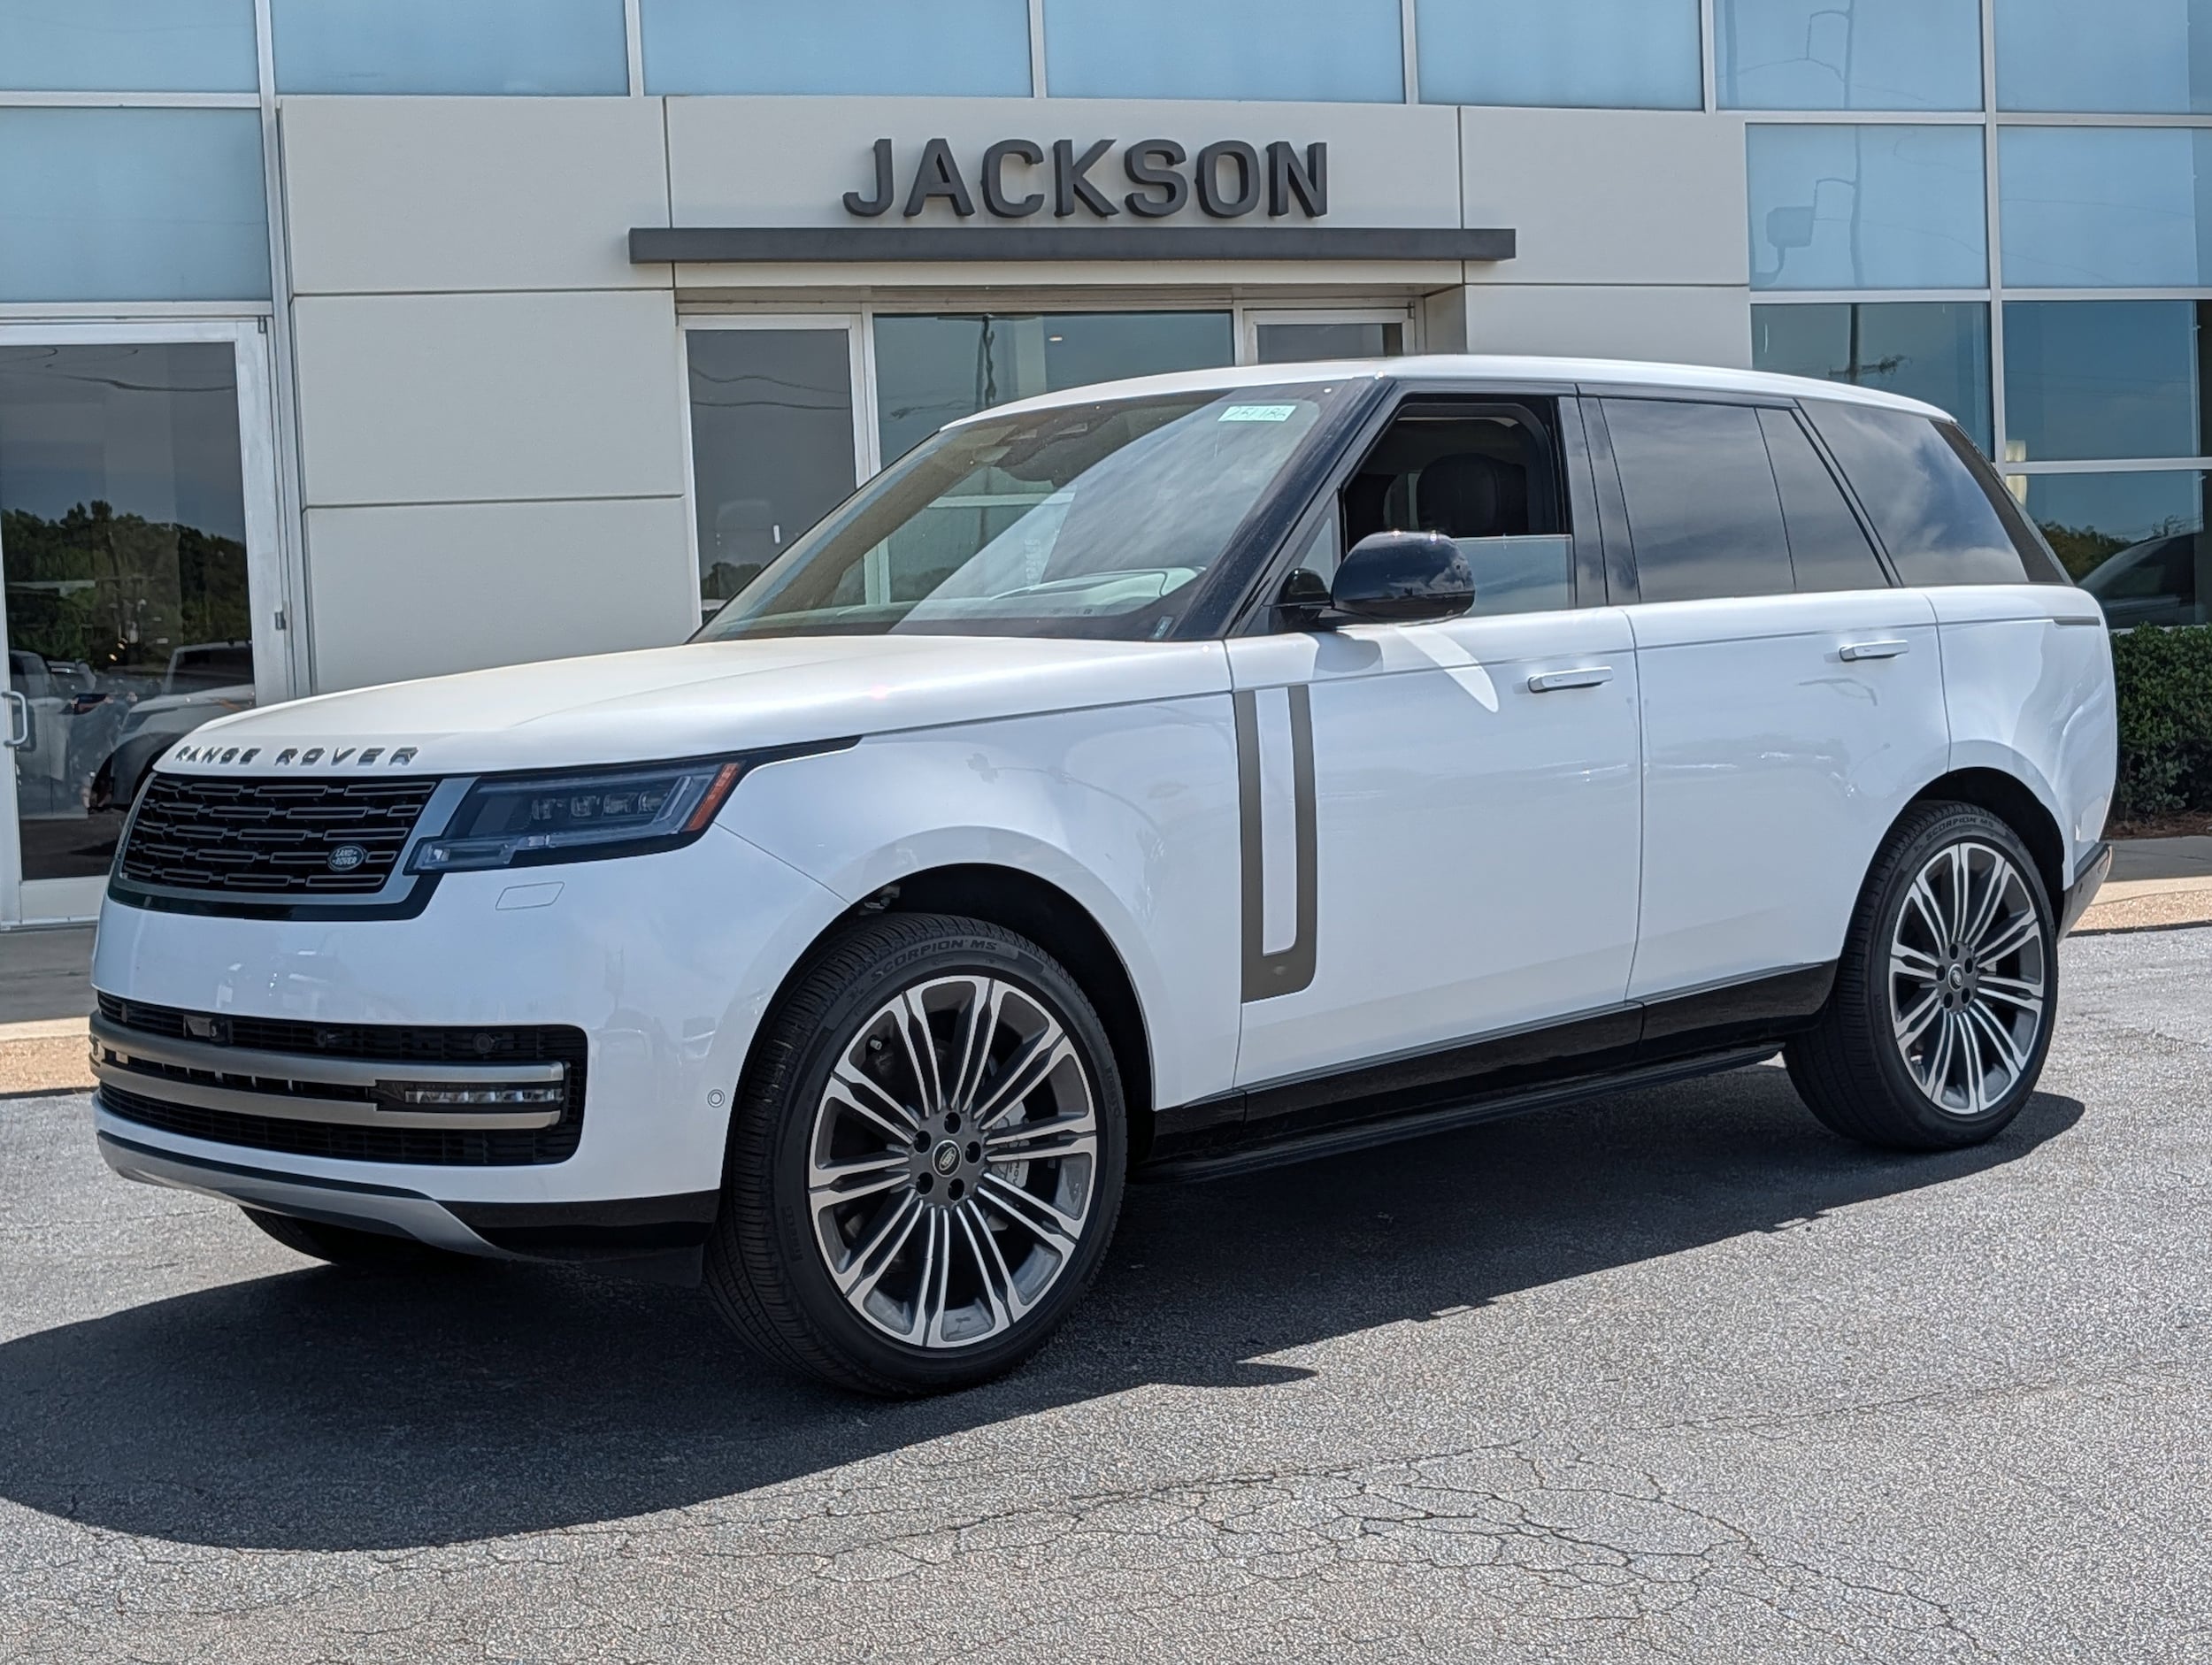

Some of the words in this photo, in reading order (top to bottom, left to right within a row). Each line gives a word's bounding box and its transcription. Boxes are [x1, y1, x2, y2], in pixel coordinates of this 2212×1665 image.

[842, 138, 1327, 219] JACKSON
[174, 745, 261, 765] RANGE
[274, 746, 419, 767] ROVER
[1925, 817, 1976, 840] SCORPION
[871, 940, 964, 983] SCORPION
[970, 940, 997, 951] MS
